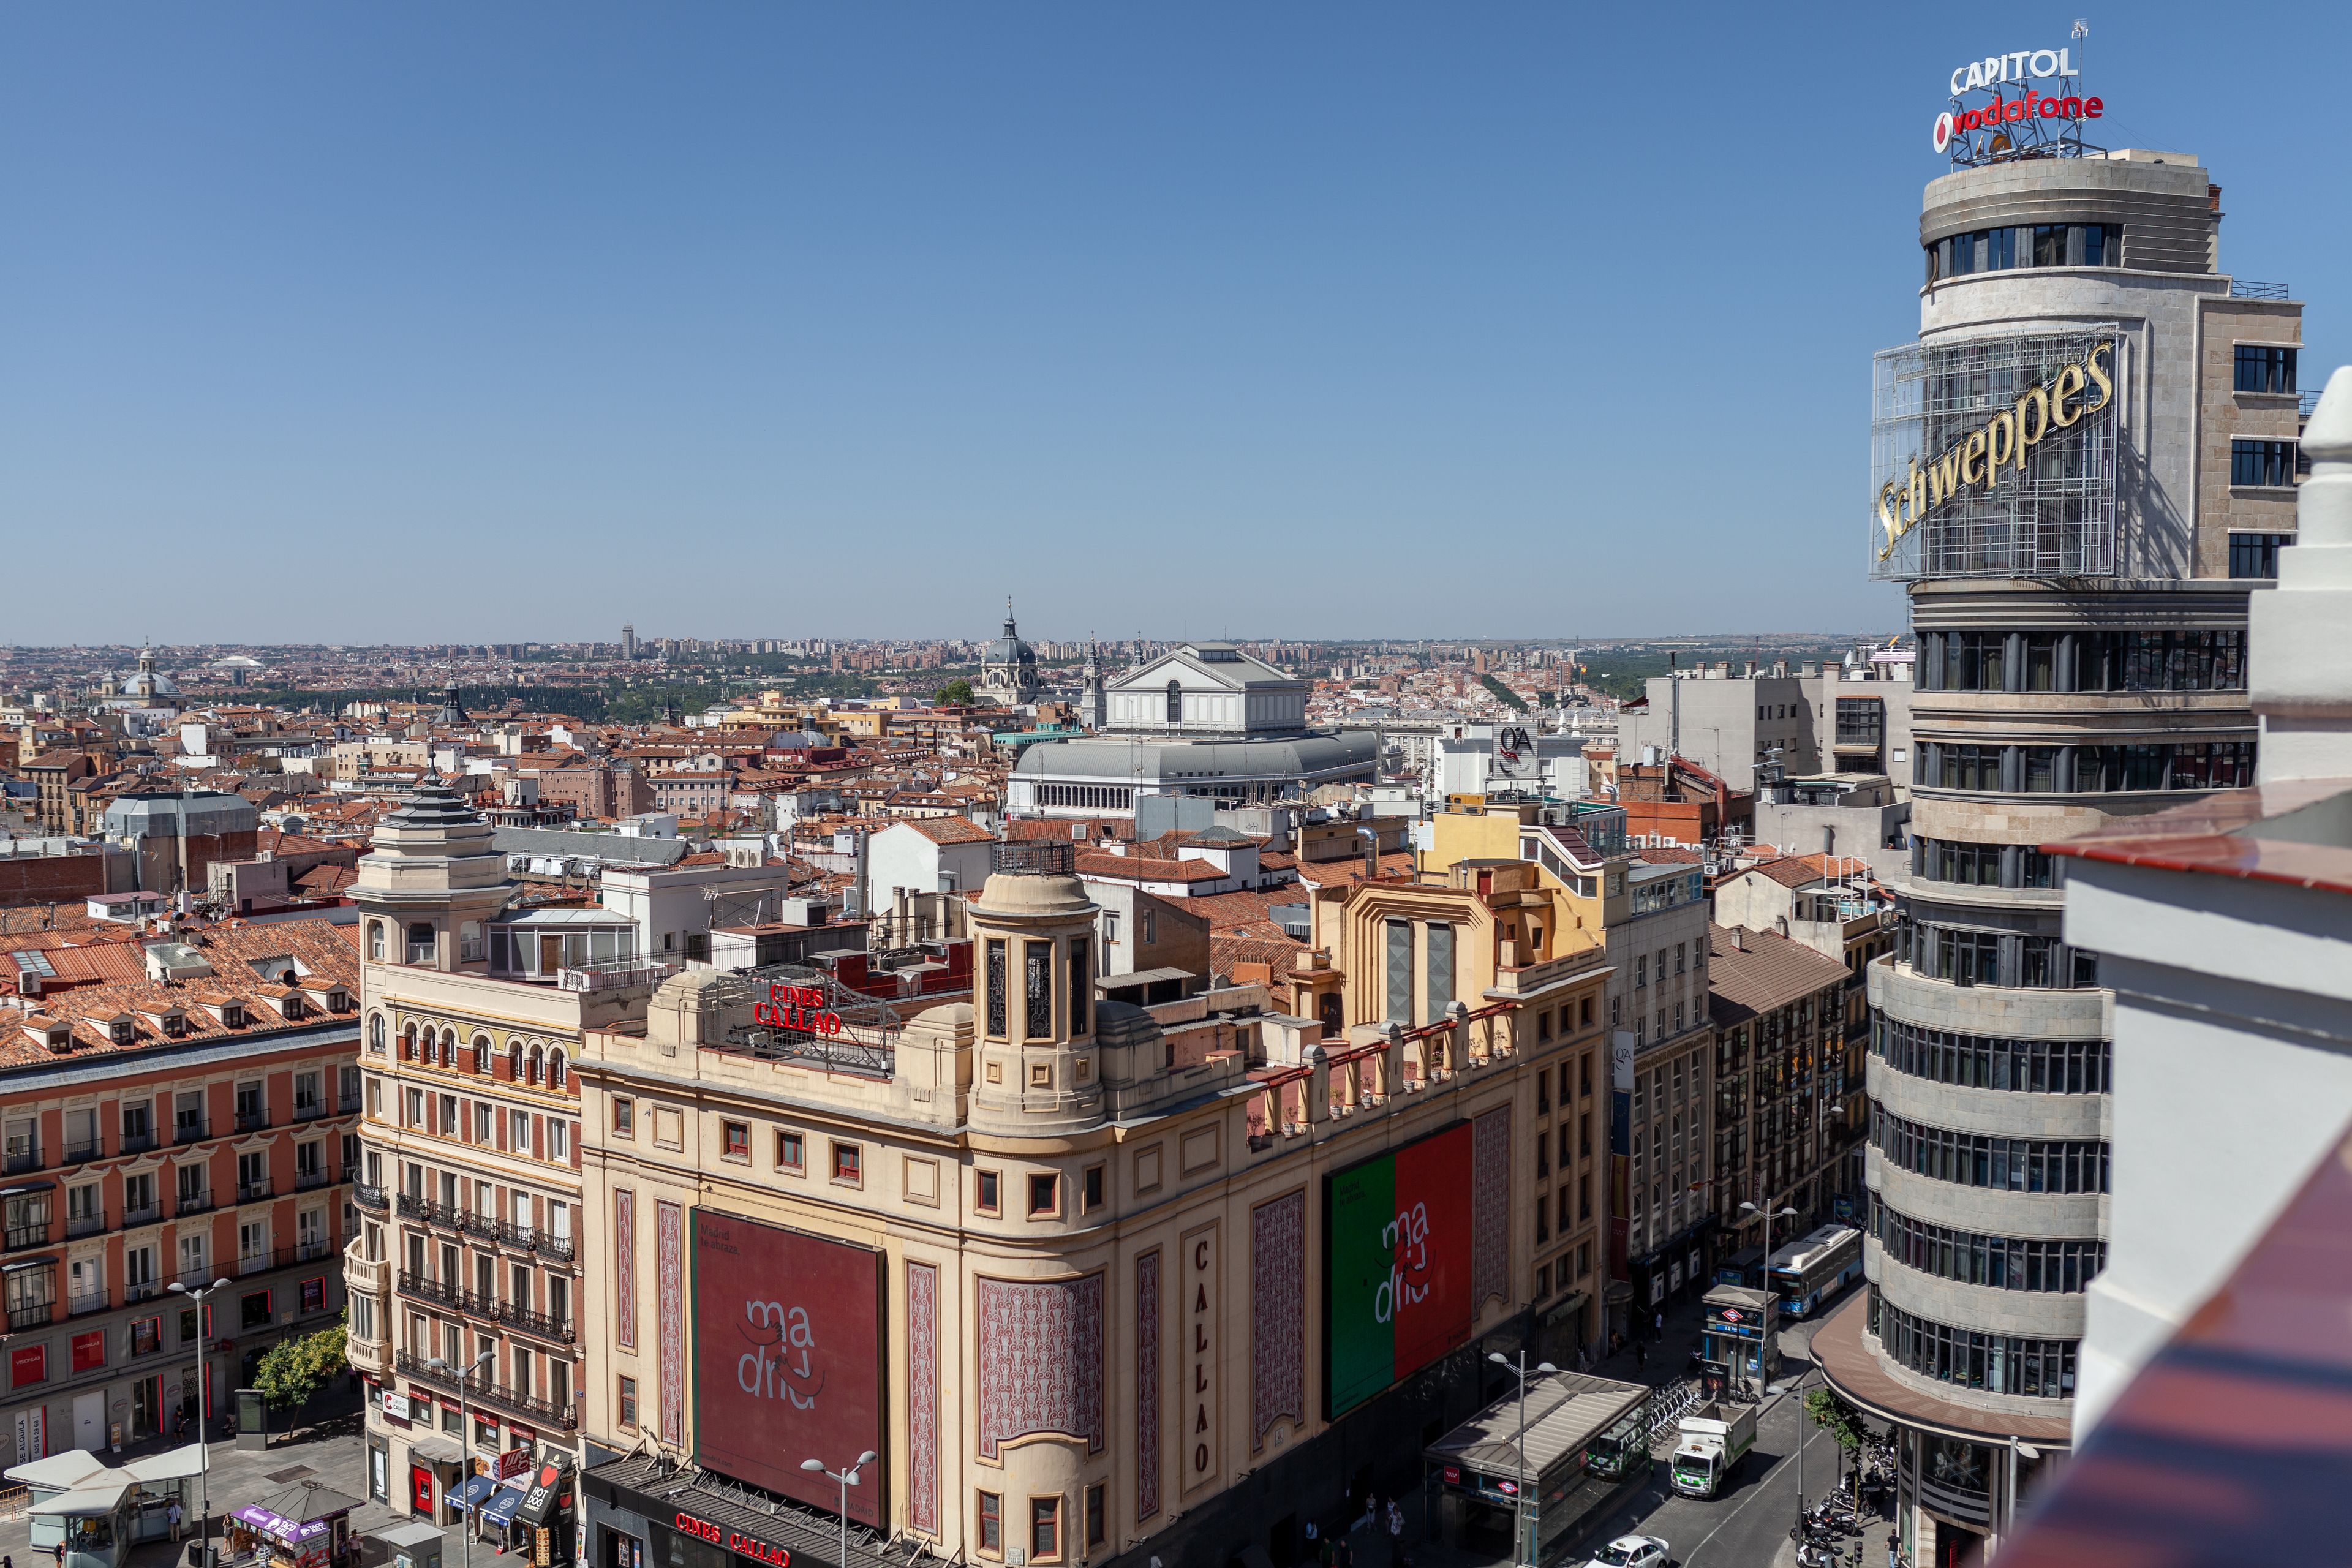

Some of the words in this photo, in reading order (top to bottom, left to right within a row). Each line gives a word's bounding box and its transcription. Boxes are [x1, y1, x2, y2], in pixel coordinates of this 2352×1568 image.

[1950, 48, 2078, 96] CAPITOL
[1952, 89, 2104, 135] vodafone
[1877, 341, 2113, 562] Schweppes
[770, 984, 824, 1008] CINES
[754, 1002, 842, 1035] CALLAO
[1339, 1179, 1360, 1196] Madrid
[700, 1223, 730, 1242] Madrid
[700, 1237, 709, 1248] te
[710, 1239, 741, 1255] abraza.
[75, 1340, 100, 1350] VISIONLAB
[15, 1355, 41, 1365] VISIONLAB
[1194, 1240, 1209, 1473] CALLAO
[393, 1398, 405, 1407] GRUPO
[393, 1405, 407, 1414] CAUCHE
[514, 1428, 529, 1437] CAPILARES
[20, 1454, 26, 1463] SE
[527, 1495, 543, 1507] DOG
[532, 1486, 549, 1499] HOT
[524, 1503, 540, 1513] GOURMET
[846, 1501, 874, 1518] ADRID
[273, 1527, 290, 1537] BELL
[279, 1520, 296, 1532] TACO
[676, 1512, 722, 1544] CINES
[729, 1533, 791, 1568] CALLAO
